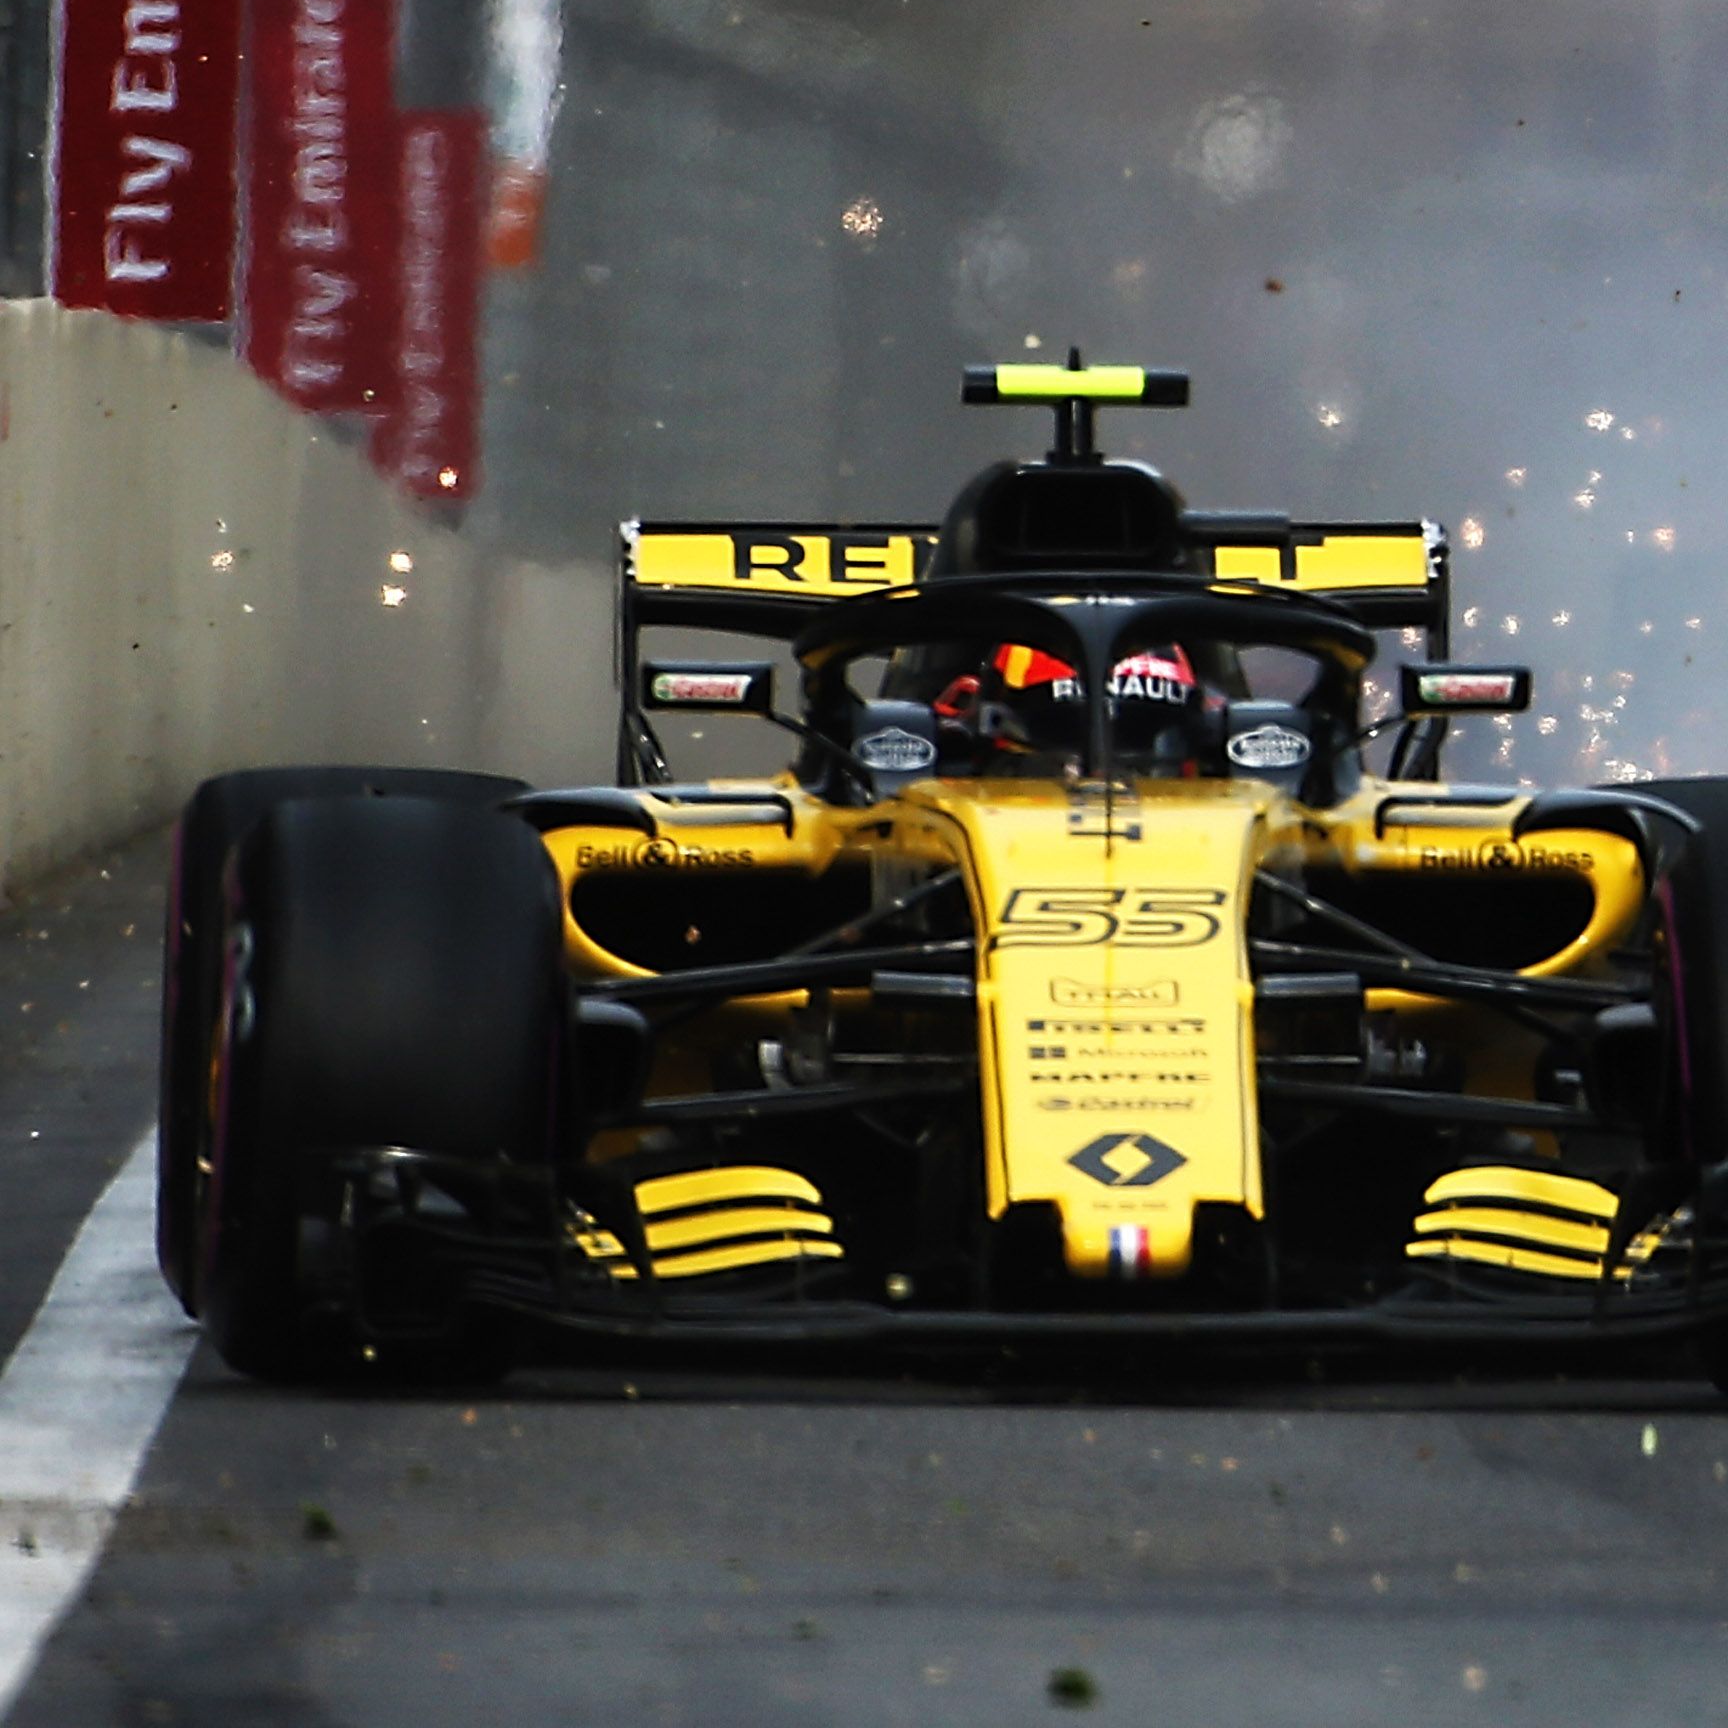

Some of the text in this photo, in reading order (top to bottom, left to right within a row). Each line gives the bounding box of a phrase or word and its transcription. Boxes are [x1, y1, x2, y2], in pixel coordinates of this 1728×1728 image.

[104, 134, 190, 285] Fly
[576, 845, 628, 869] Bell
[685, 845, 754, 869] Ross
[1529, 847, 1595, 870] Ross
[990, 887, 1227, 952] 55
